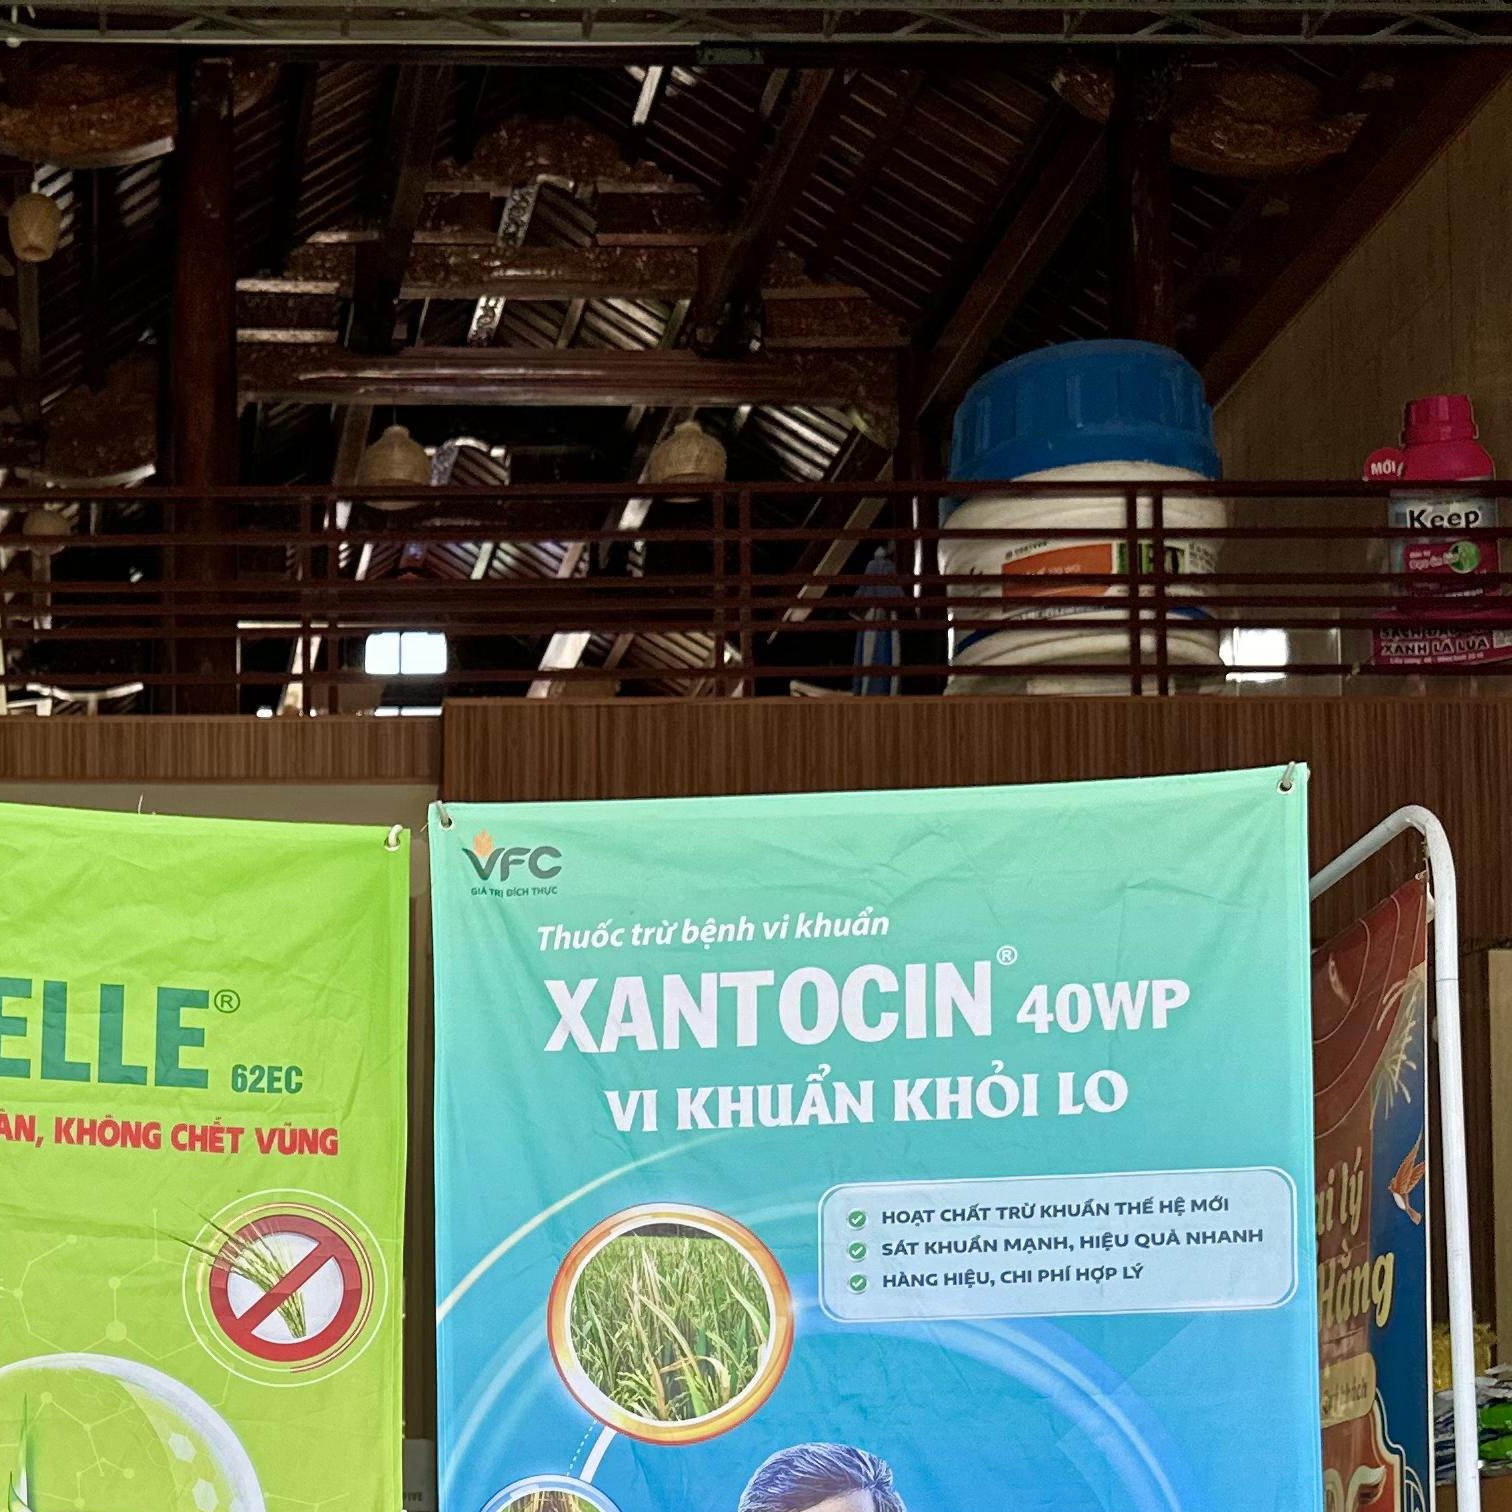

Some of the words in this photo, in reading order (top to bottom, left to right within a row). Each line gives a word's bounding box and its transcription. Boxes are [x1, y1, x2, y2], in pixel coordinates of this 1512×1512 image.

[1408, 508, 1481, 528] Keep
[461, 845, 563, 882] VFC
[471, 886, 487, 897] GIÁ
[489, 887, 504, 899] TRỊ
[531, 885, 558, 898] THỰC
[536, 919, 625, 952] Thuốc
[631, 921, 679, 946] trừ
[682, 915, 756, 950] bệnh
[762, 914, 789, 940] vi
[795, 905, 890, 939] khuẩn
[1016, 979, 1191, 1035] 40WP
[230, 1063, 304, 1096] 62EC
[604, 1088, 659, 1133] VI
[676, 1063, 876, 1132] KHUẨN
[892, 1060, 1040, 1122] KHỎI
[1056, 1069, 1129, 1115] LO
[54, 1114, 162, 1150] KHÔNG
[170, 1115, 245, 1155] CHẾT
[254, 1121, 339, 1157] VŨNG
[881, 1209, 936, 1228] HOẠT
[940, 1201, 992, 1223] CHẤT
[995, 1200, 1037, 1220] TRỪ
[1040, 1198, 1111, 1219] KHUẨN
[1114, 1196, 1155, 1216] THẾ
[1159, 1196, 1186, 1218] HỆ
[1191, 1195, 1230, 1213] MỚI
[881, 1236, 920, 1257] SÁT
[924, 1233, 999, 1255] KHUẨN
[1003, 1234, 1075, 1256] MẠNH,
[1079, 1231, 1130, 1253] HIỆU
[1134, 1228, 1182, 1249] QUẢ
[1186, 1228, 1264, 1246] NHANH
[882, 1269, 939, 1289] HÀNG
[943, 1268, 996, 1289] HIỆU,
[1000, 1269, 1033, 1285] CHI
[1037, 1264, 1071, 1283] PHÍ
[1075, 1264, 1118, 1284] HỢP
[1122, 1262, 1144, 1281] LÝ
